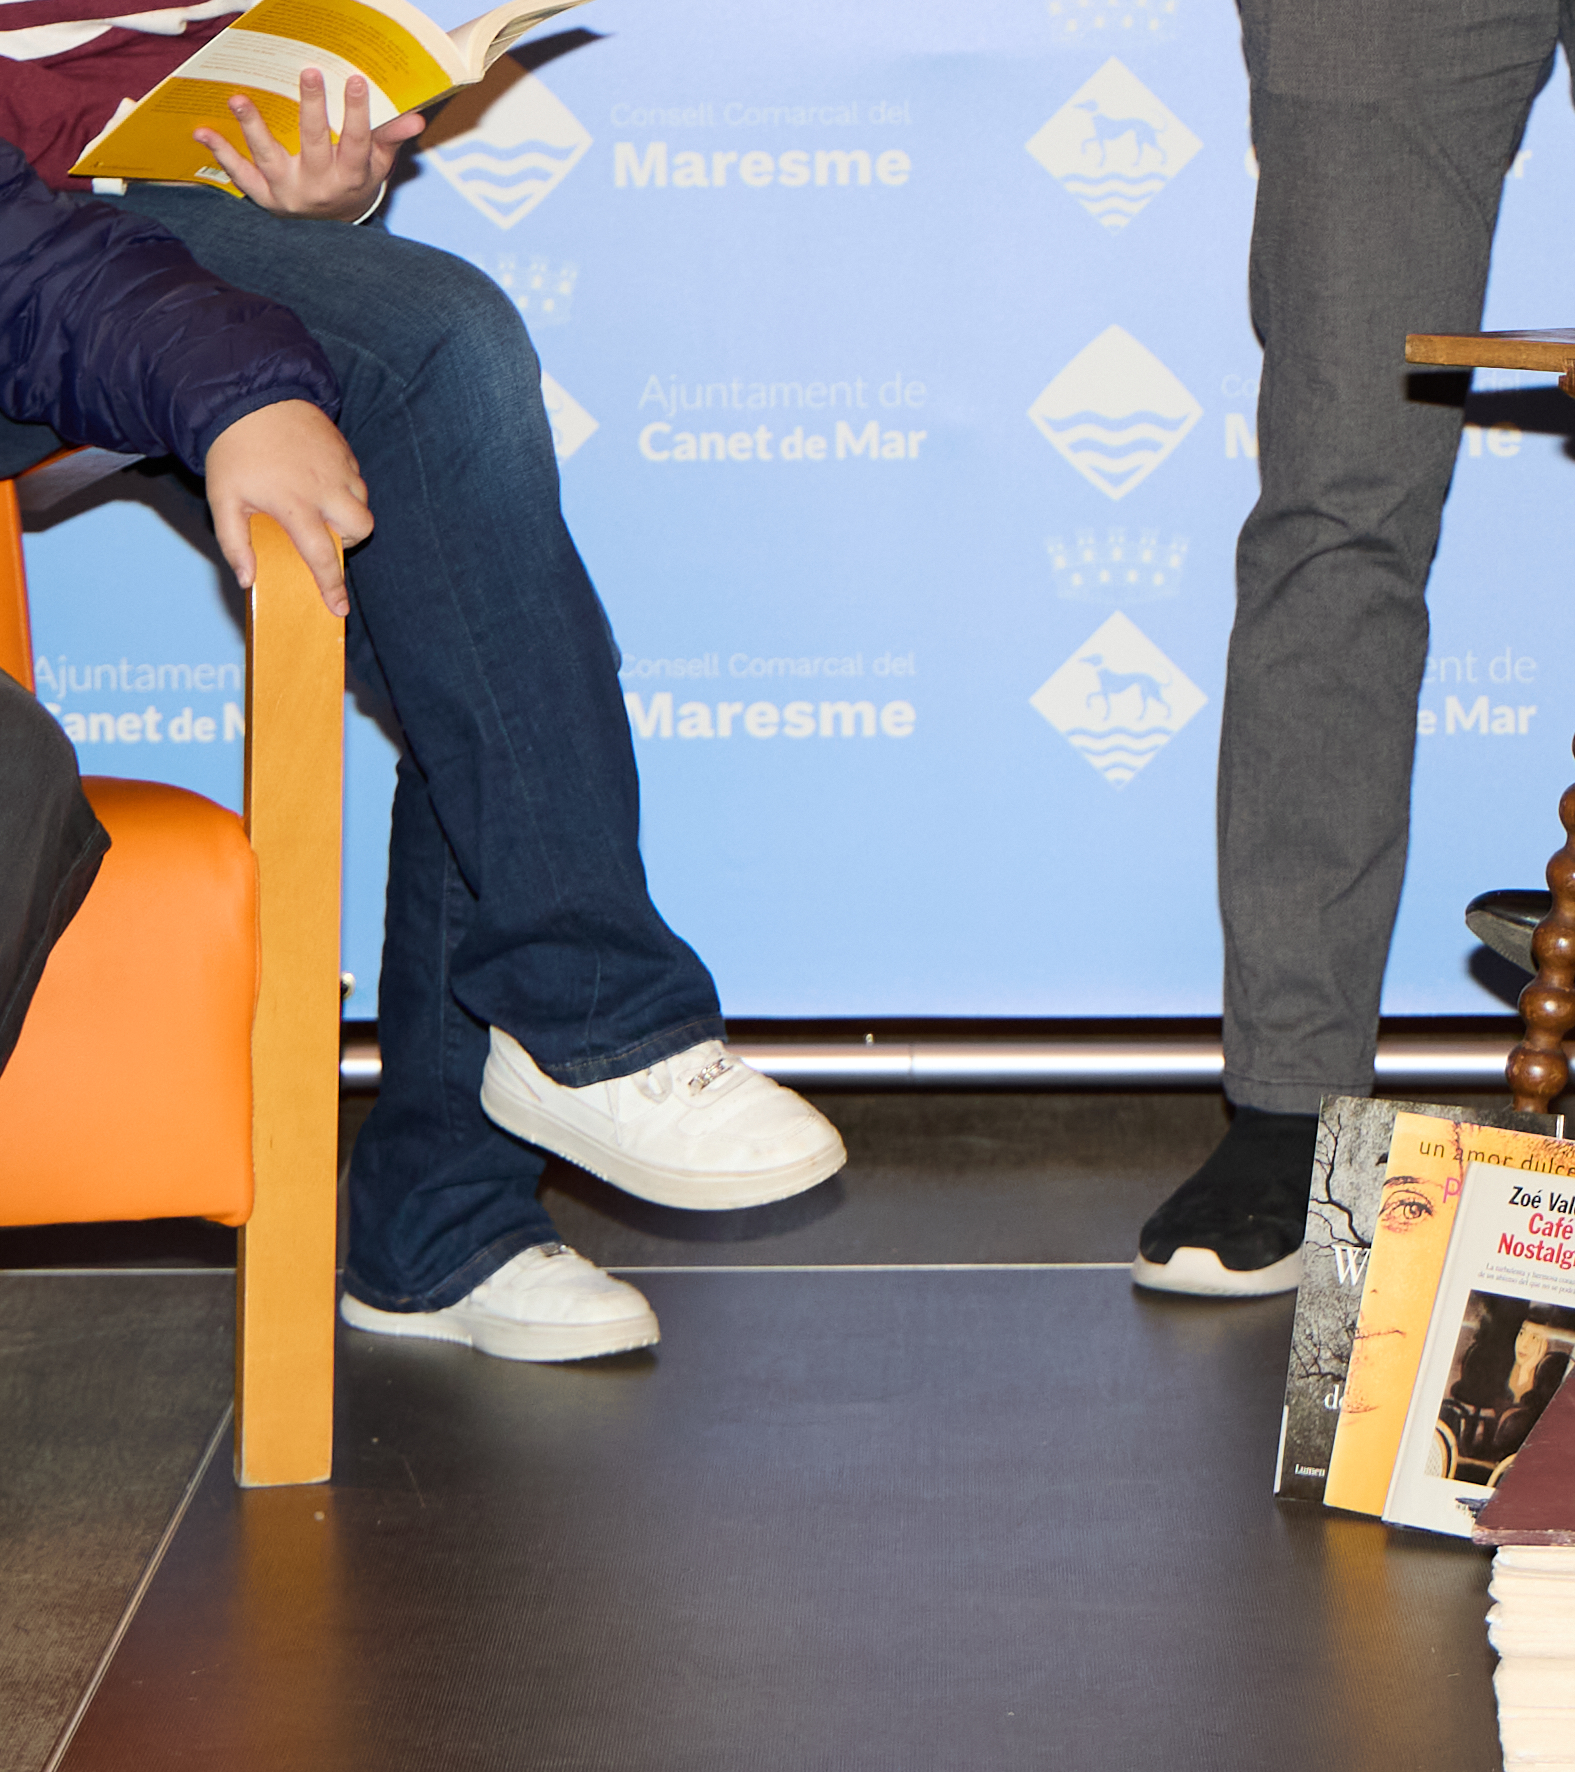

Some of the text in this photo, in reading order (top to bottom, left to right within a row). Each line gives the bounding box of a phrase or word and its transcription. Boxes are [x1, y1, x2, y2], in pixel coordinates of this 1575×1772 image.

[615, 142, 911, 187] Maresme
[639, 372, 926, 418] Ajuntament de
[639, 421, 926, 461] Canet de Mar
[728, 652, 865, 678] Comarcal
[872, 651, 916, 677] del
[629, 693, 916, 739] Maresme
[1420, 1140, 1445, 1159] un
[1508, 1186, 1541, 1209] Zoé
[1528, 1212, 1574, 1240] Café
